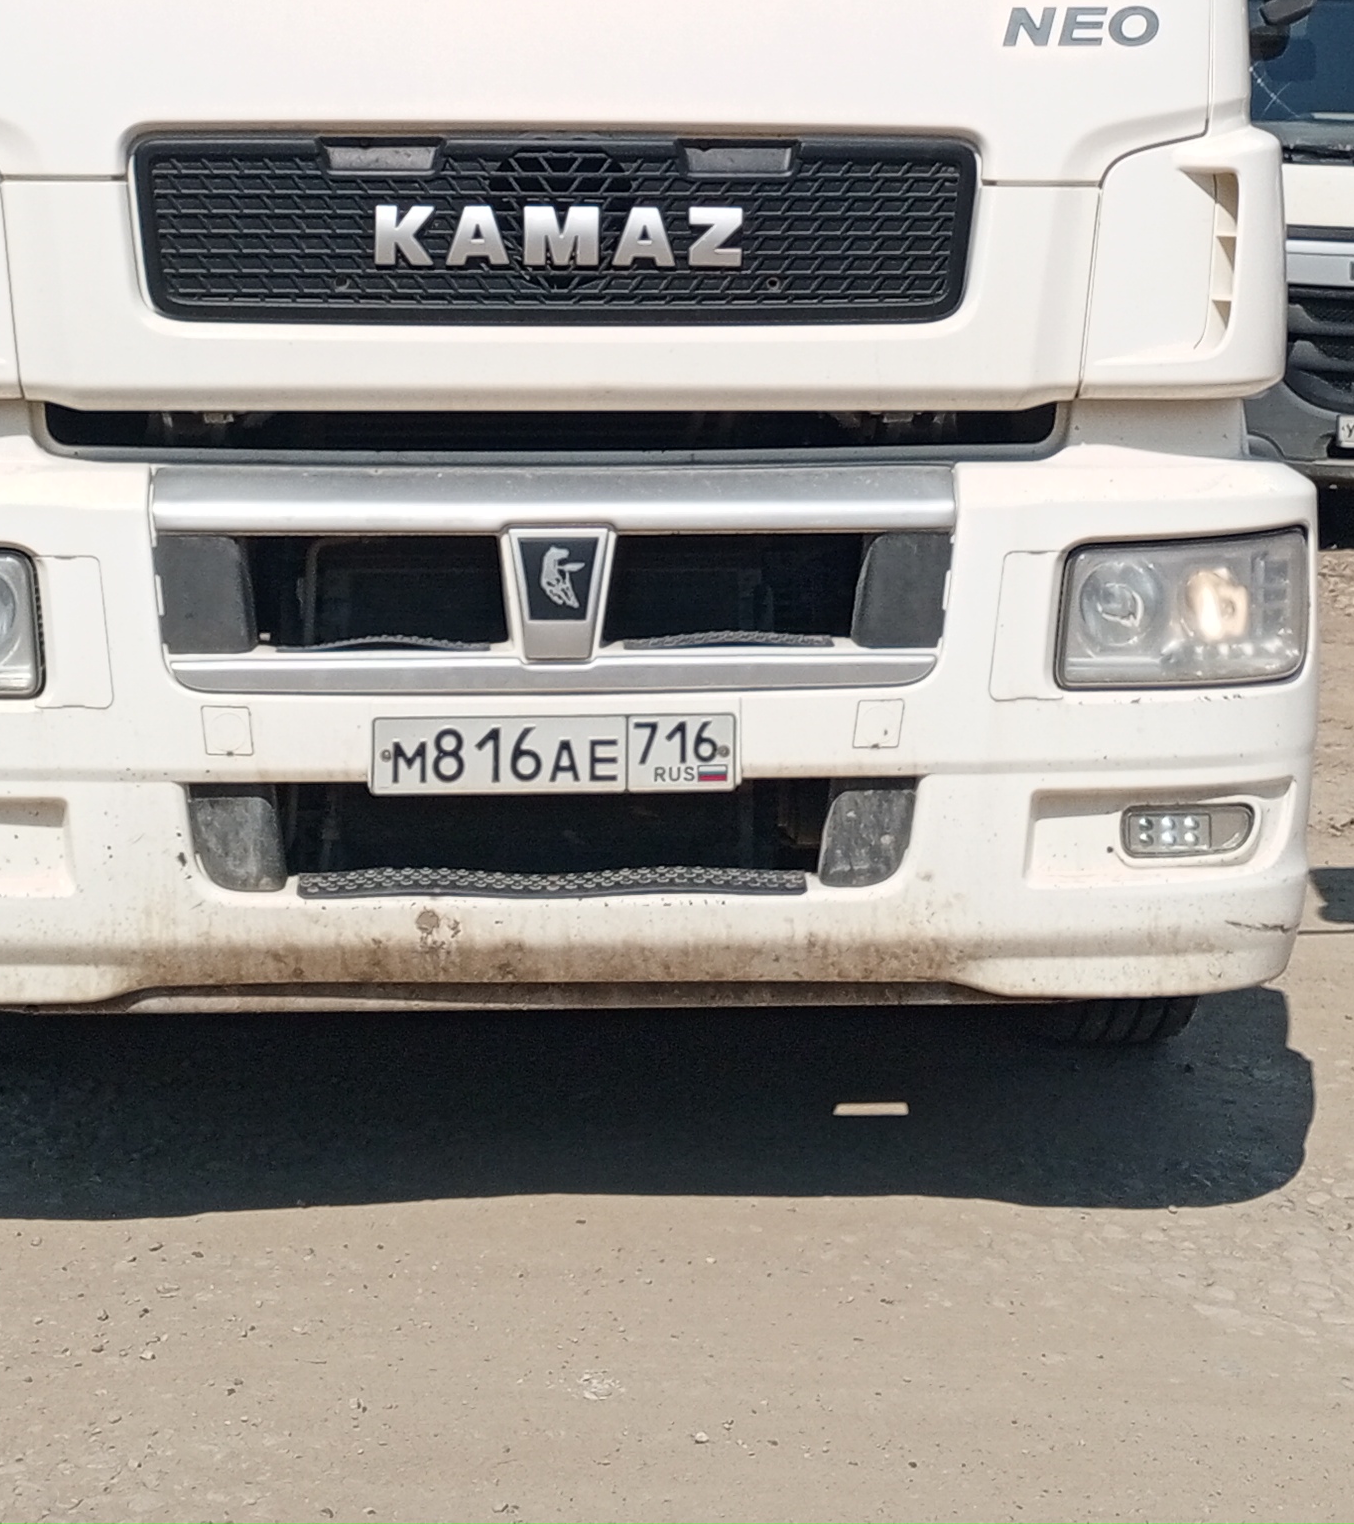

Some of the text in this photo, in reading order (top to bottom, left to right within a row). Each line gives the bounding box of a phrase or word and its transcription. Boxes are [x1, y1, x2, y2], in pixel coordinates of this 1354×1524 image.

[1002, 5, 1160, 47] NEO
[374, 204, 744, 267] KAMAZ
[633, 720, 718, 765] 716
[653, 766, 695, 783] RUS
